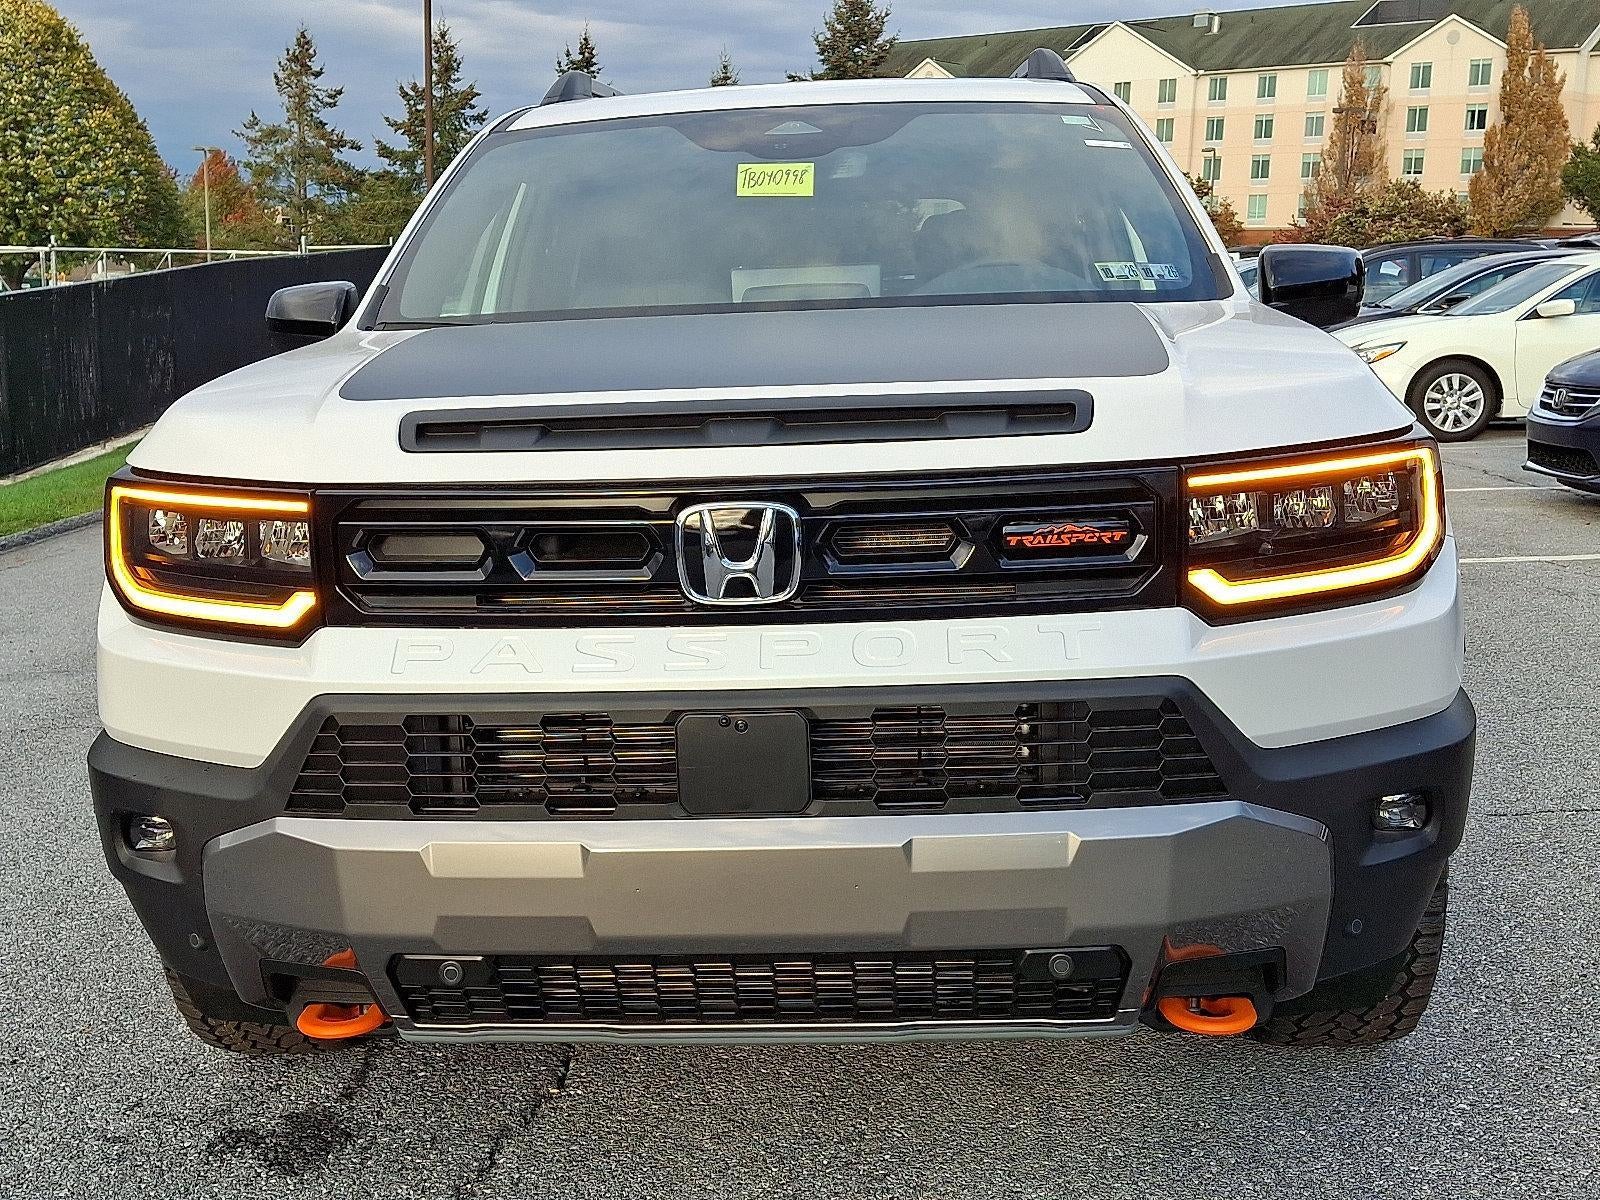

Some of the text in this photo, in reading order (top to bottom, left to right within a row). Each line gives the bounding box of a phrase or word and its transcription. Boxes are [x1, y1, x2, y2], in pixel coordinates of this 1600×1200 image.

[1124, 264, 1139, 278] 26
[1164, 265, 1179, 278] 26
[1005, 531, 1128, 548] TRAILSPORT
[390, 622, 1102, 677] PASSPORT
